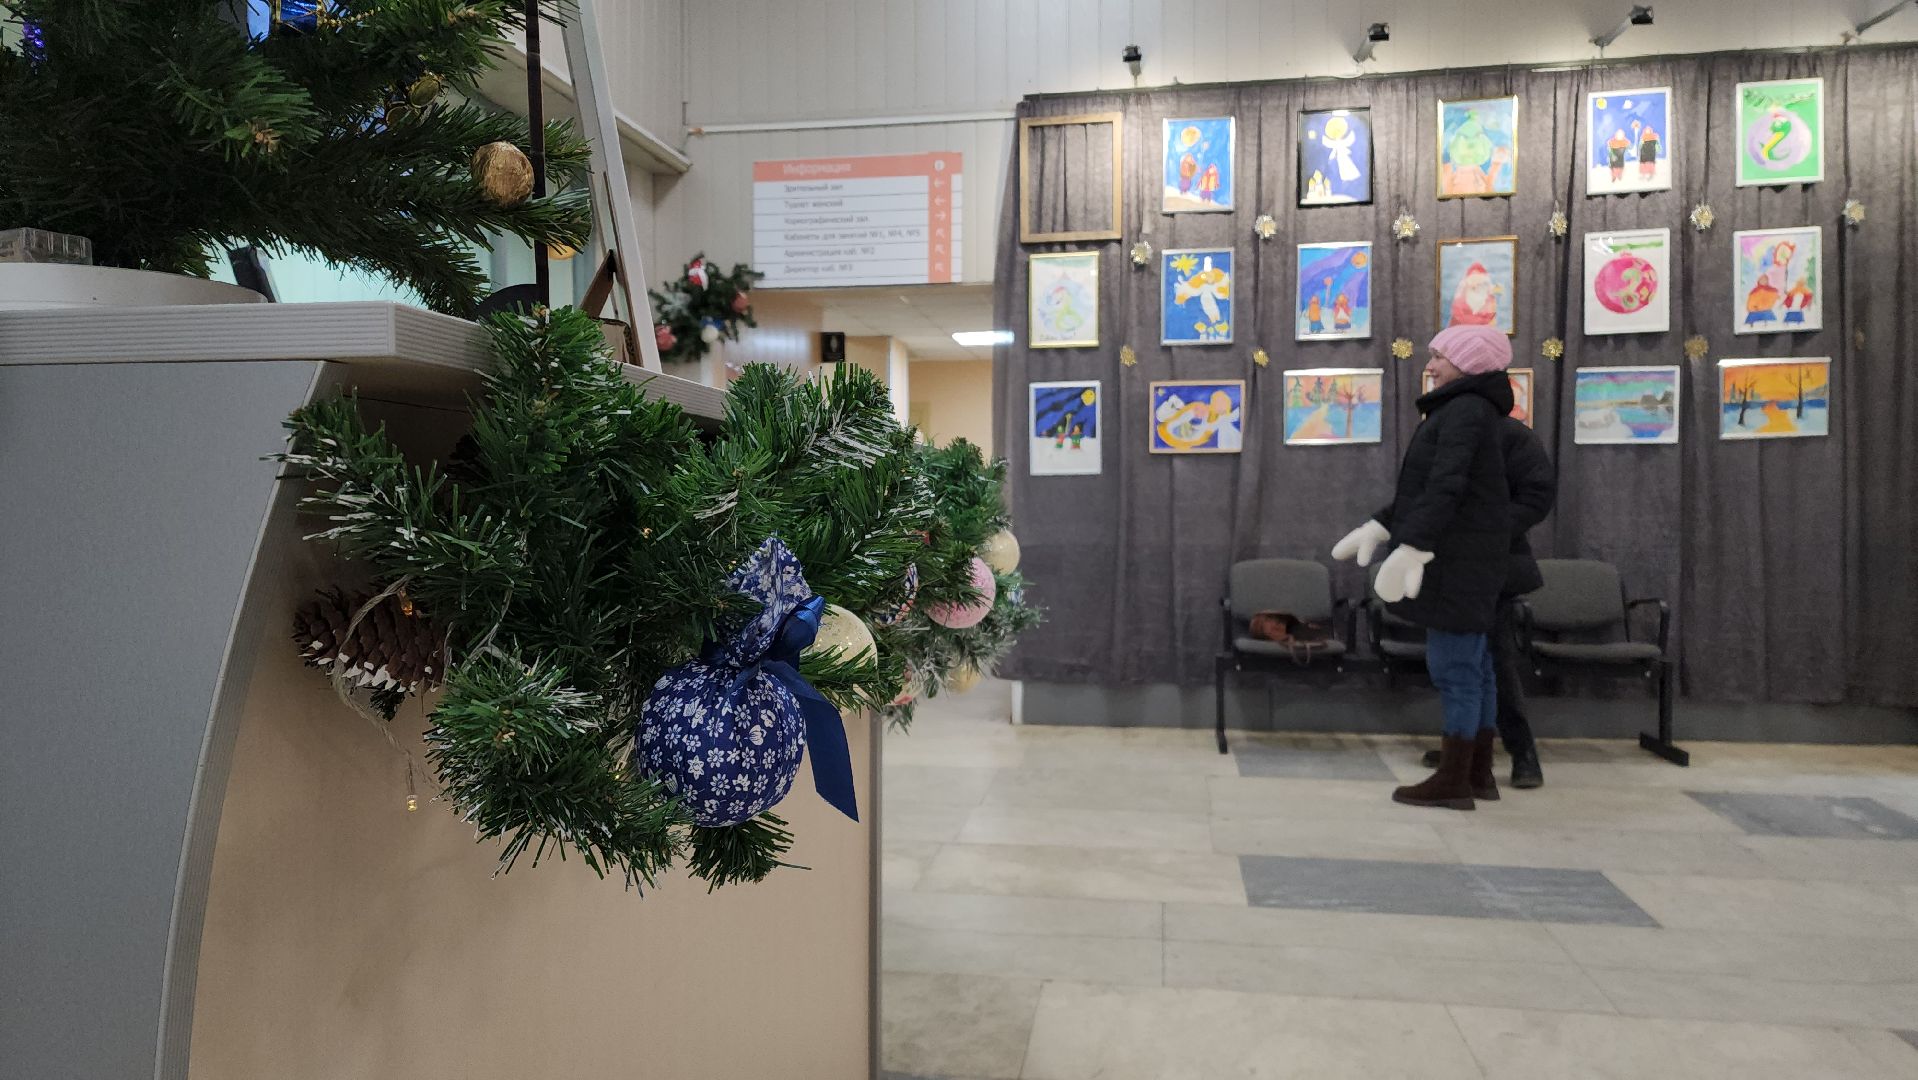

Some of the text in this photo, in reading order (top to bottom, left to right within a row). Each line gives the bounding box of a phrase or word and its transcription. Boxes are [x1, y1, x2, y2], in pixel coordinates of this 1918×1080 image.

[783, 163, 851, 176] Информация
[784, 183, 828, 193] Зрительный
[784, 200, 808, 209] Туалет
